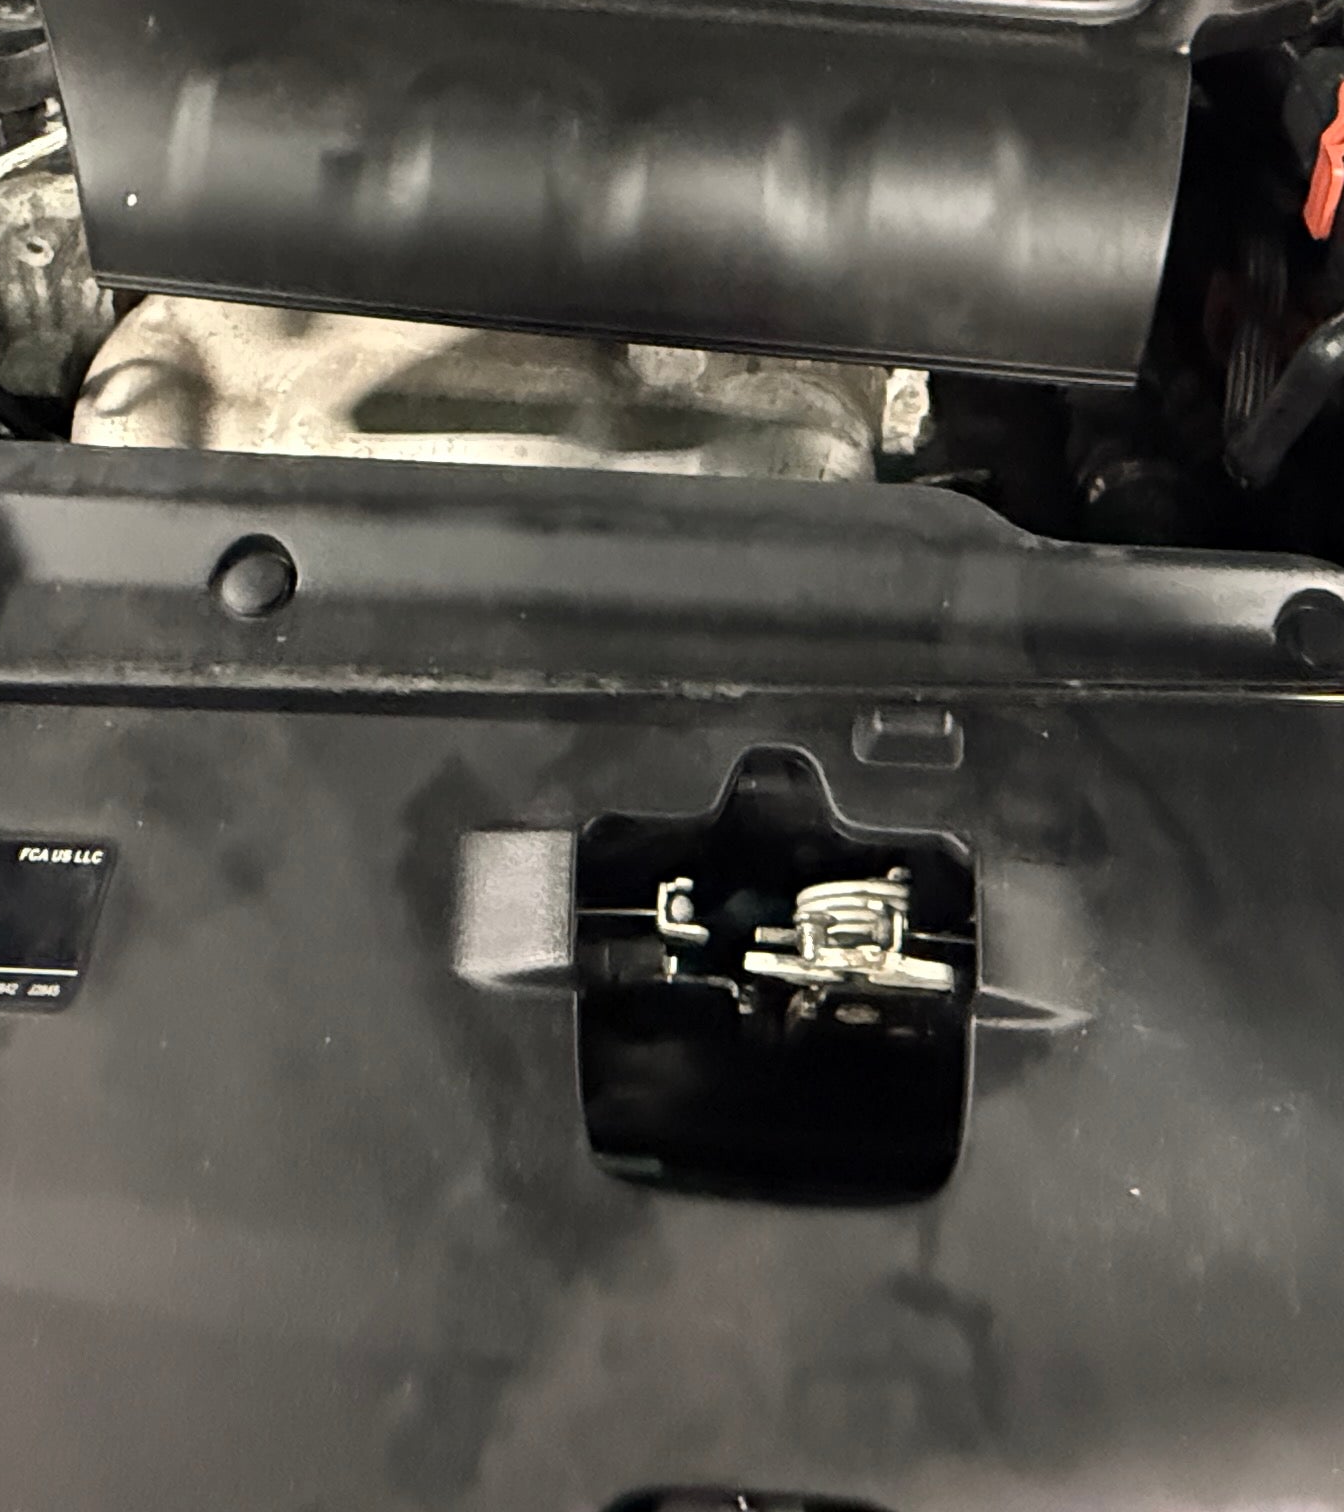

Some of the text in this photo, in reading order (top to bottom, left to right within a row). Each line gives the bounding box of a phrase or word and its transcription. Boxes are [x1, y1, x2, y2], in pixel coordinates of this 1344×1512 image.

[18, 847, 104, 865] FCA US LLC
